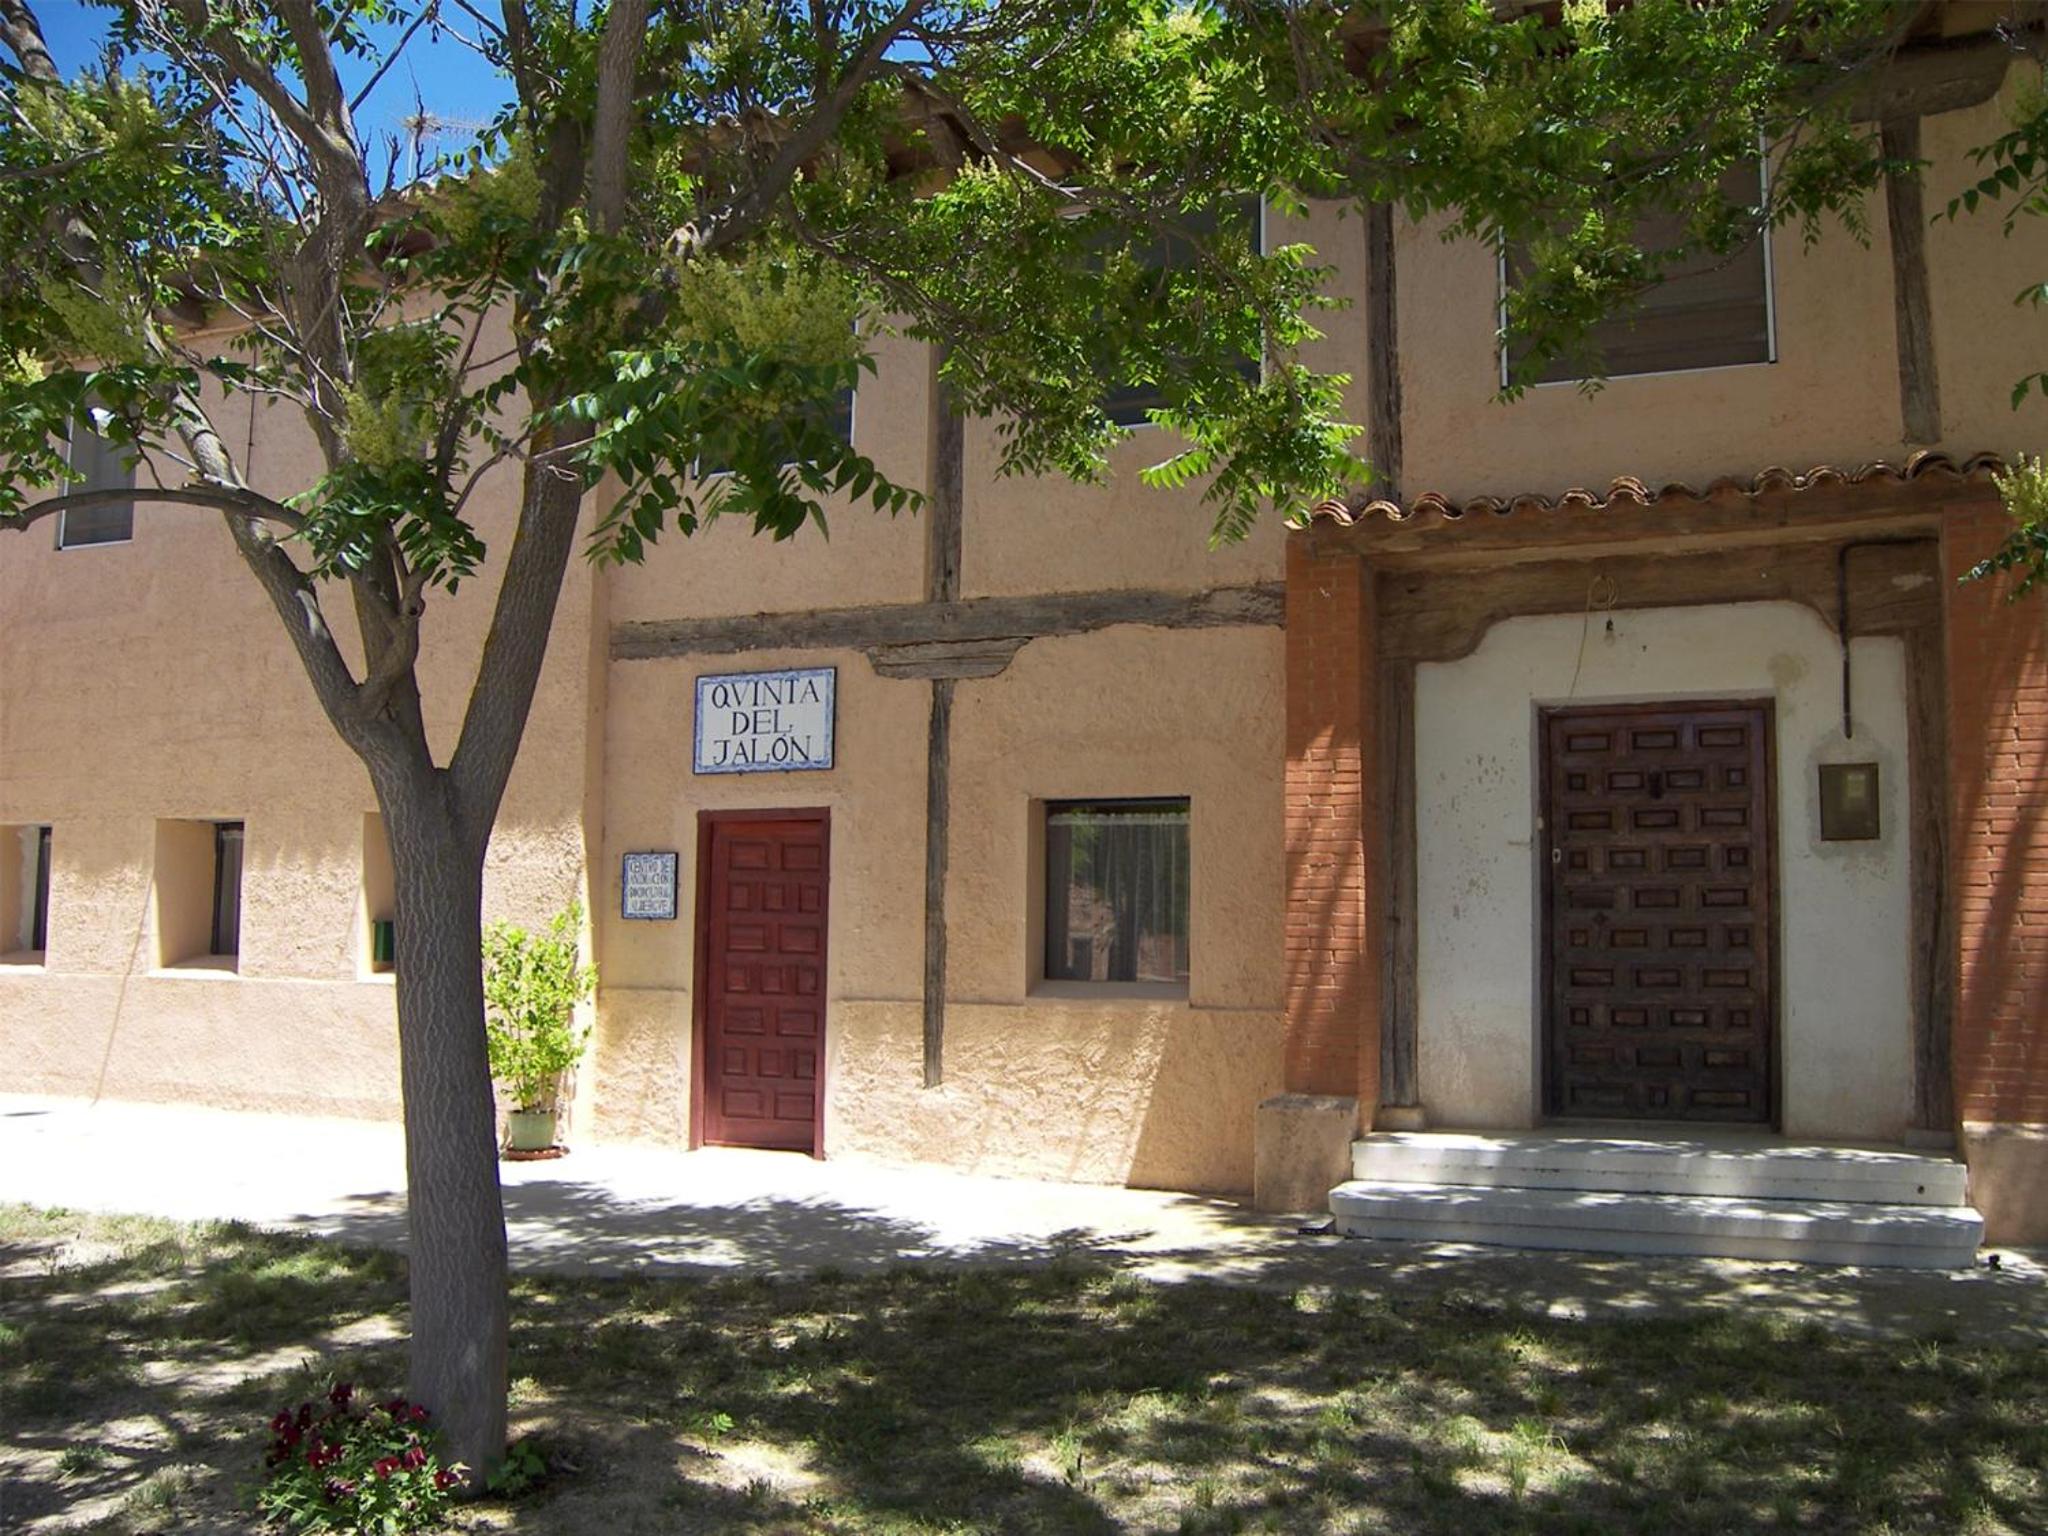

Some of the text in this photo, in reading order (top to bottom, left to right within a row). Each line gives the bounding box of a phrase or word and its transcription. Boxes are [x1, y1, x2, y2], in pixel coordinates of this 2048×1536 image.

[712, 678, 820, 709] QVINTA
[732, 709, 793, 736] DEL
[712, 733, 811, 766] JALÓN
